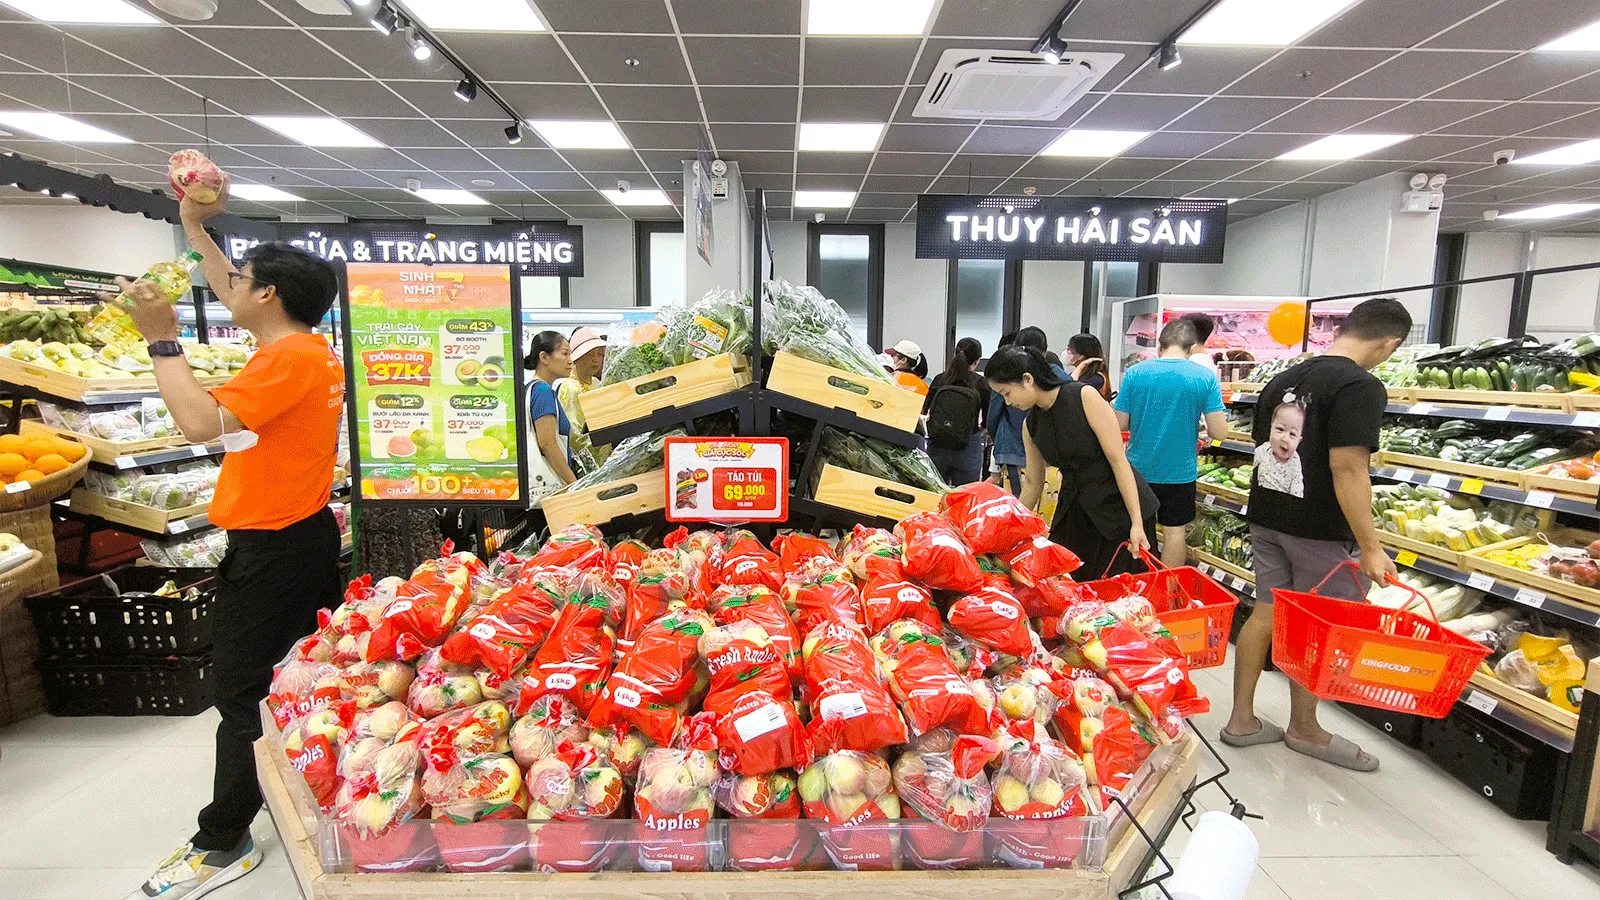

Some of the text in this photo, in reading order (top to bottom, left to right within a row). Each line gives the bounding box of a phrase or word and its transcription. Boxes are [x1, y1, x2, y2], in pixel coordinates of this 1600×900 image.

[945, 206, 1202, 245] THỦY HẢI SẢN
[352, 241, 372, 261] &
[484, 233, 573, 270] MIỆNG
[399, 271, 435, 282] SINH
[404, 282, 444, 298] NHẬT
[366, 321, 421, 332] TRÁI CÂY
[469, 321, 494, 331] 43%
[356, 332, 432, 347] VIỆT NAM
[405, 351, 425, 362] GIÁ
[372, 363, 425, 382] 37K
[727, 469, 762, 482] TÁO TÚI
[724, 485, 765, 501] 69.000
[645, 813, 701, 832] Apples
[656, 852, 695, 861] Good life
